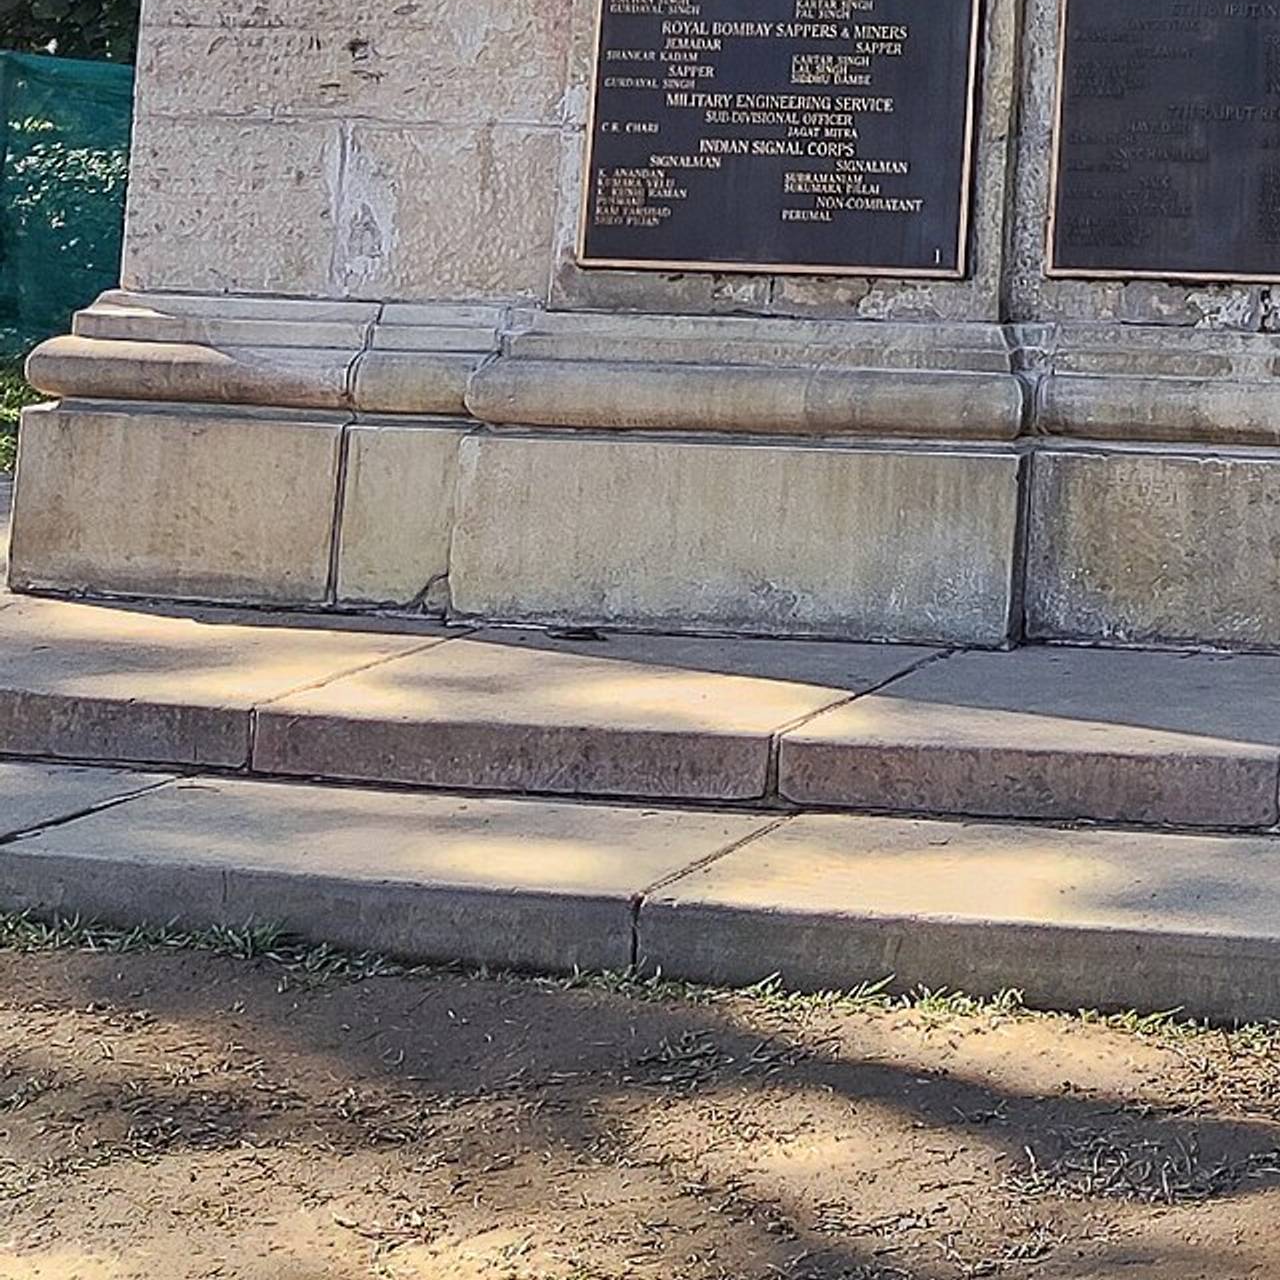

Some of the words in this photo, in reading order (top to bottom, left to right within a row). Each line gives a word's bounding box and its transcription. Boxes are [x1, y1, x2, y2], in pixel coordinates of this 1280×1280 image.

[662, 21, 708, 35] ROYAL
[713, 22, 773, 36] BOMBAY
[776, 23, 837, 37] SAPPERS
[841, 28, 849, 38] &
[854, 26, 907, 39] MINERS
[667, 93, 732, 107] MILITARY
[736, 95, 831, 109] ENGINEERING
[835, 97, 893, 111] SERVICE
[700, 140, 749, 153] INDIAN
[752, 141, 803, 155] SIGNAL
[808, 142, 854, 156] CORPS
